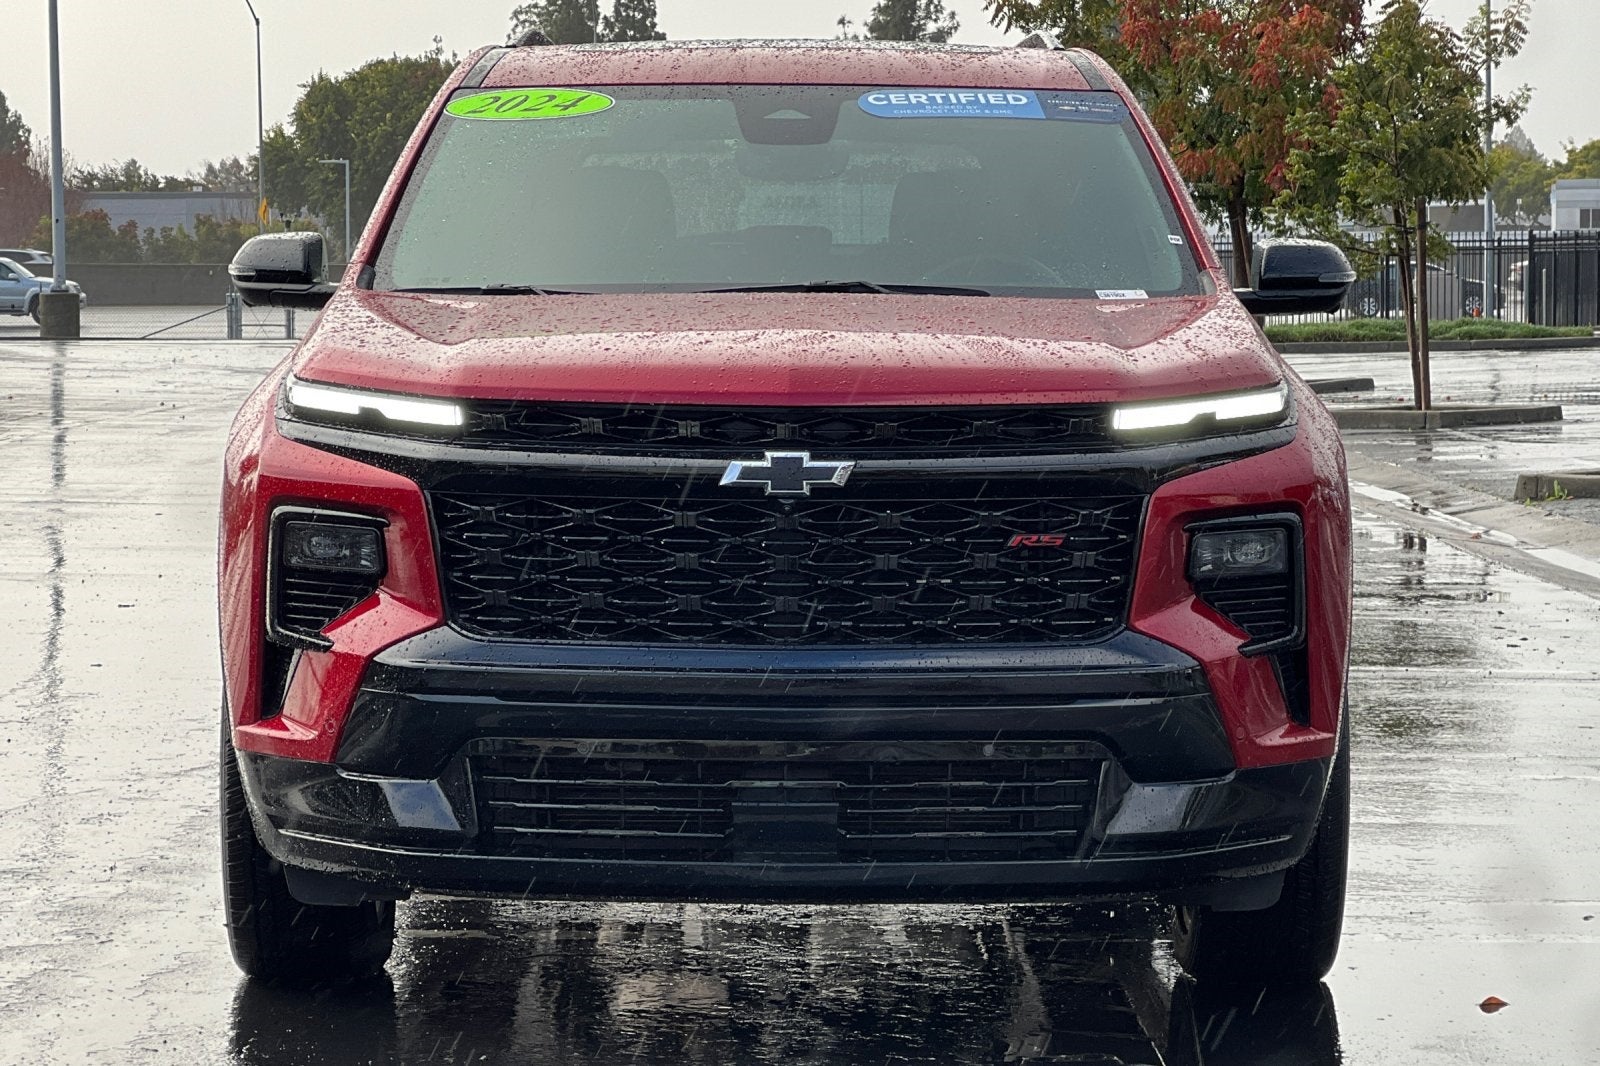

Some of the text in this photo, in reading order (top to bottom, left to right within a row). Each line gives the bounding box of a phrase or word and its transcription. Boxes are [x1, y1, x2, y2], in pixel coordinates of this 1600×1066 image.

[464, 94, 592, 115] 2024
[867, 93, 1028, 105] CERTIFIED
[1008, 533, 1067, 547] RS
